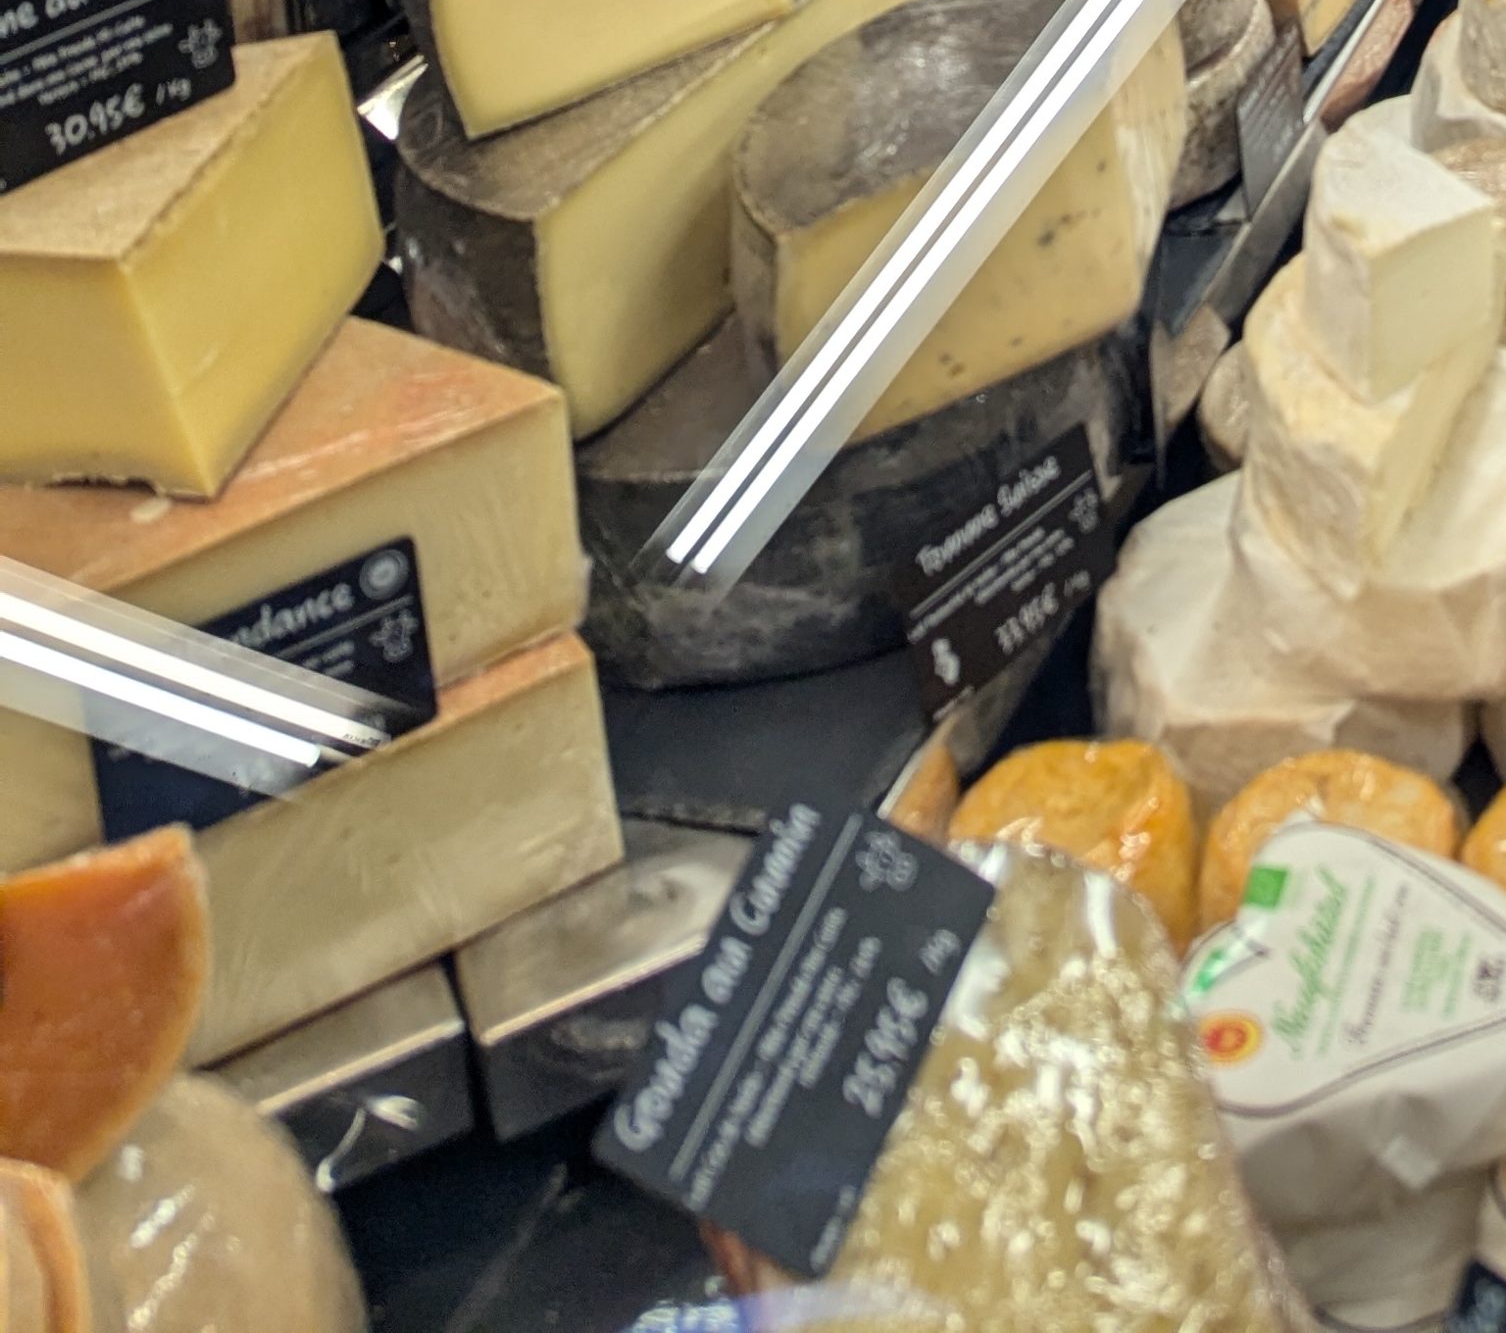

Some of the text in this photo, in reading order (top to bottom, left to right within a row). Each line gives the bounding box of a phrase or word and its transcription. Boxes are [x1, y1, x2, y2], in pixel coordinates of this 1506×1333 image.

[915, 455, 1061, 576] Tomme Suisse
[614, 1004, 719, 1152] Gouda
[702, 936, 753, 1005] au
[729, 803, 820, 935] Cumin
